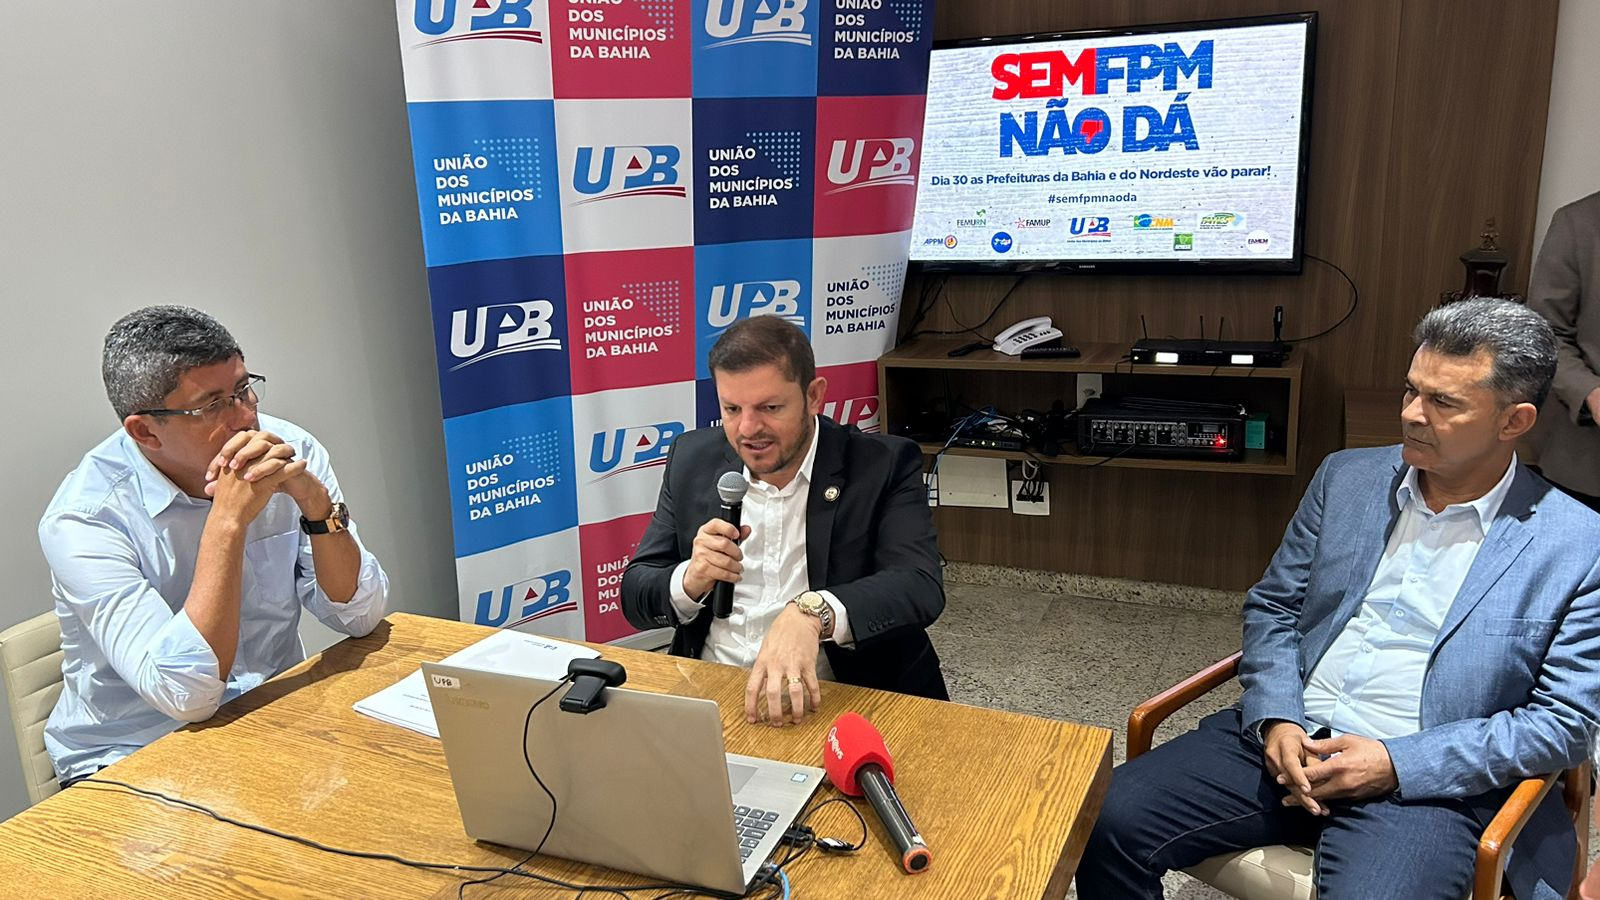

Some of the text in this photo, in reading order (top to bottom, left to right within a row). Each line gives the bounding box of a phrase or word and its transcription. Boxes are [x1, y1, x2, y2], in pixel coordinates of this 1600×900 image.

[414, 0, 533, 36] UPB
[568, 9, 604, 22] DOS
[704, 0, 808, 38] UPB
[835, 14, 865, 26] DOS
[569, 24, 667, 41] MUNICÍPIOS
[834, 28, 914, 43] MUNICÍPIOS
[570, 46, 651, 59] DA BAHIA
[834, 47, 900, 59] DA BAHIA
[999, 92, 1200, 158] NÃO DÁ
[709, 145, 756, 161] UNIÃO
[826, 138, 915, 184] UPB
[433, 154, 488, 171] UNIÃO
[573, 145, 681, 195] UPB
[709, 164, 740, 177] DOS
[435, 174, 469, 190] DOS
[709, 176, 794, 193] MUNICÍPIOS
[931, 165, 1272, 186] Dia 30 as Prefeituras da Bahia e do Nordeste vão parar!
[437, 188, 534, 207] MUNICÍPIOS
[710, 194, 778, 209] DA BAHIA
[1048, 192, 1137, 204] #semfpmnaoda
[440, 207, 518, 225] DA BAHIA
[1070, 216, 1110, 235] UPB
[827, 278, 870, 292] UNIÃO
[583, 296, 634, 313] UNIÃO
[707, 279, 801, 327] UPB
[826, 295, 854, 307] DOS
[826, 303, 896, 321] MUNICÍPIOS
[450, 300, 554, 358] UPB
[584, 315, 617, 329] DOS
[825, 320, 886, 335] DA BAHIA
[585, 325, 673, 344] MUNICÍPIOS
[586, 341, 659, 359] DA BAHIA
[465, 454, 514, 475] UNIÃO
[467, 473, 499, 491] DOS
[468, 475, 555, 505] MUNICÍPIOS
[470, 493, 541, 520] DA BAHIA
[597, 555, 630, 573] UNIÃ
[474, 569, 572, 628] UPB
[599, 601, 619, 613] DA
